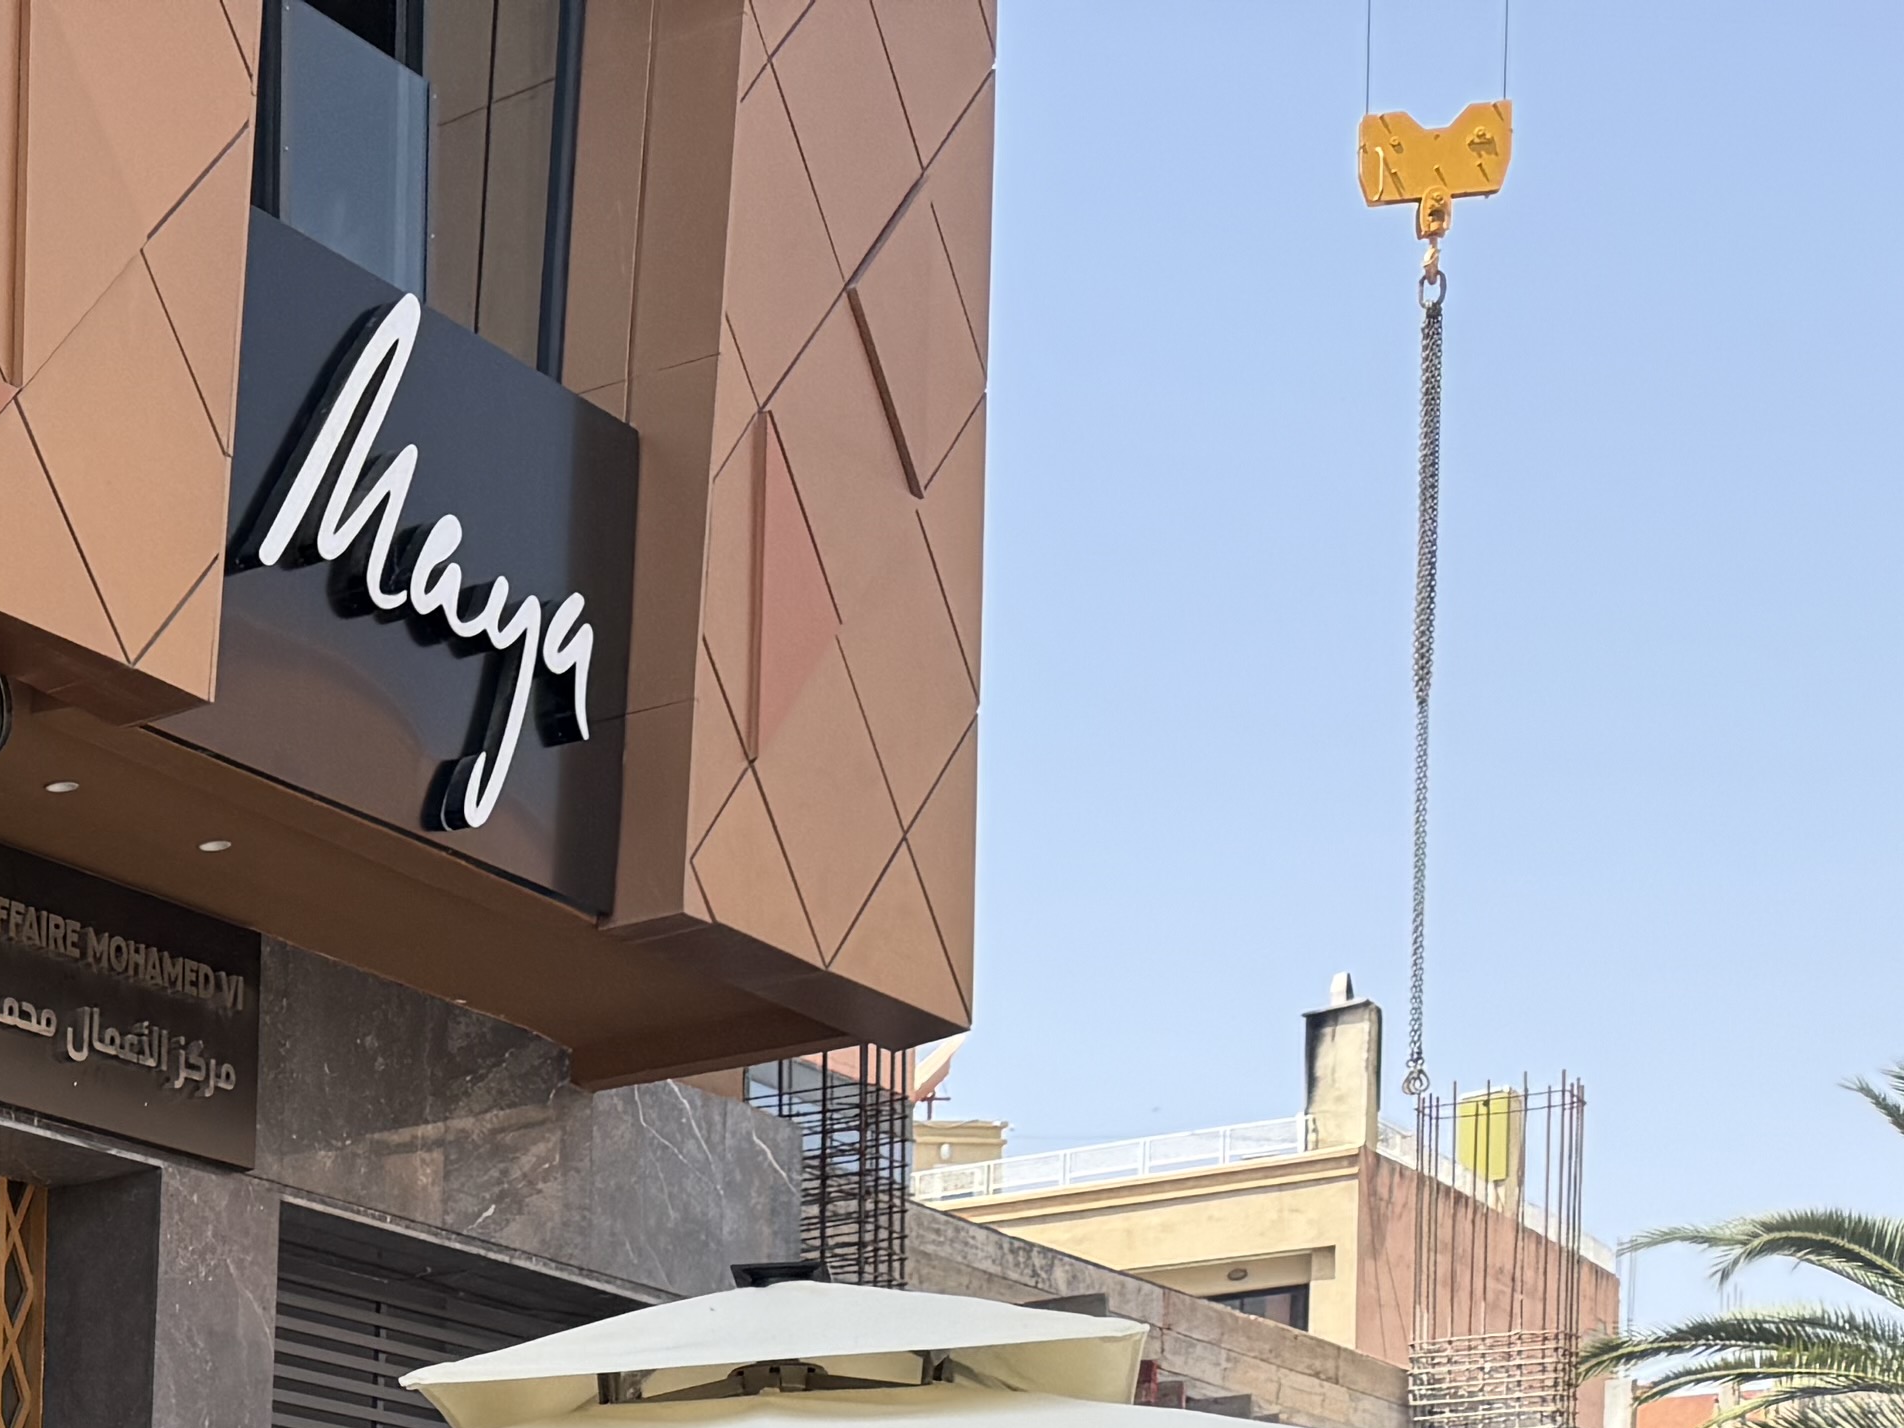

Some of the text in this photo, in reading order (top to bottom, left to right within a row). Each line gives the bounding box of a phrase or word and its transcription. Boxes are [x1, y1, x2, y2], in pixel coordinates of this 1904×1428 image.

[258, 293, 593, 828] Maya
[83, 926, 214, 999] MOHAMED
[218, 971, 244, 1011] VI
[172, 1036, 237, 1097] مركز
